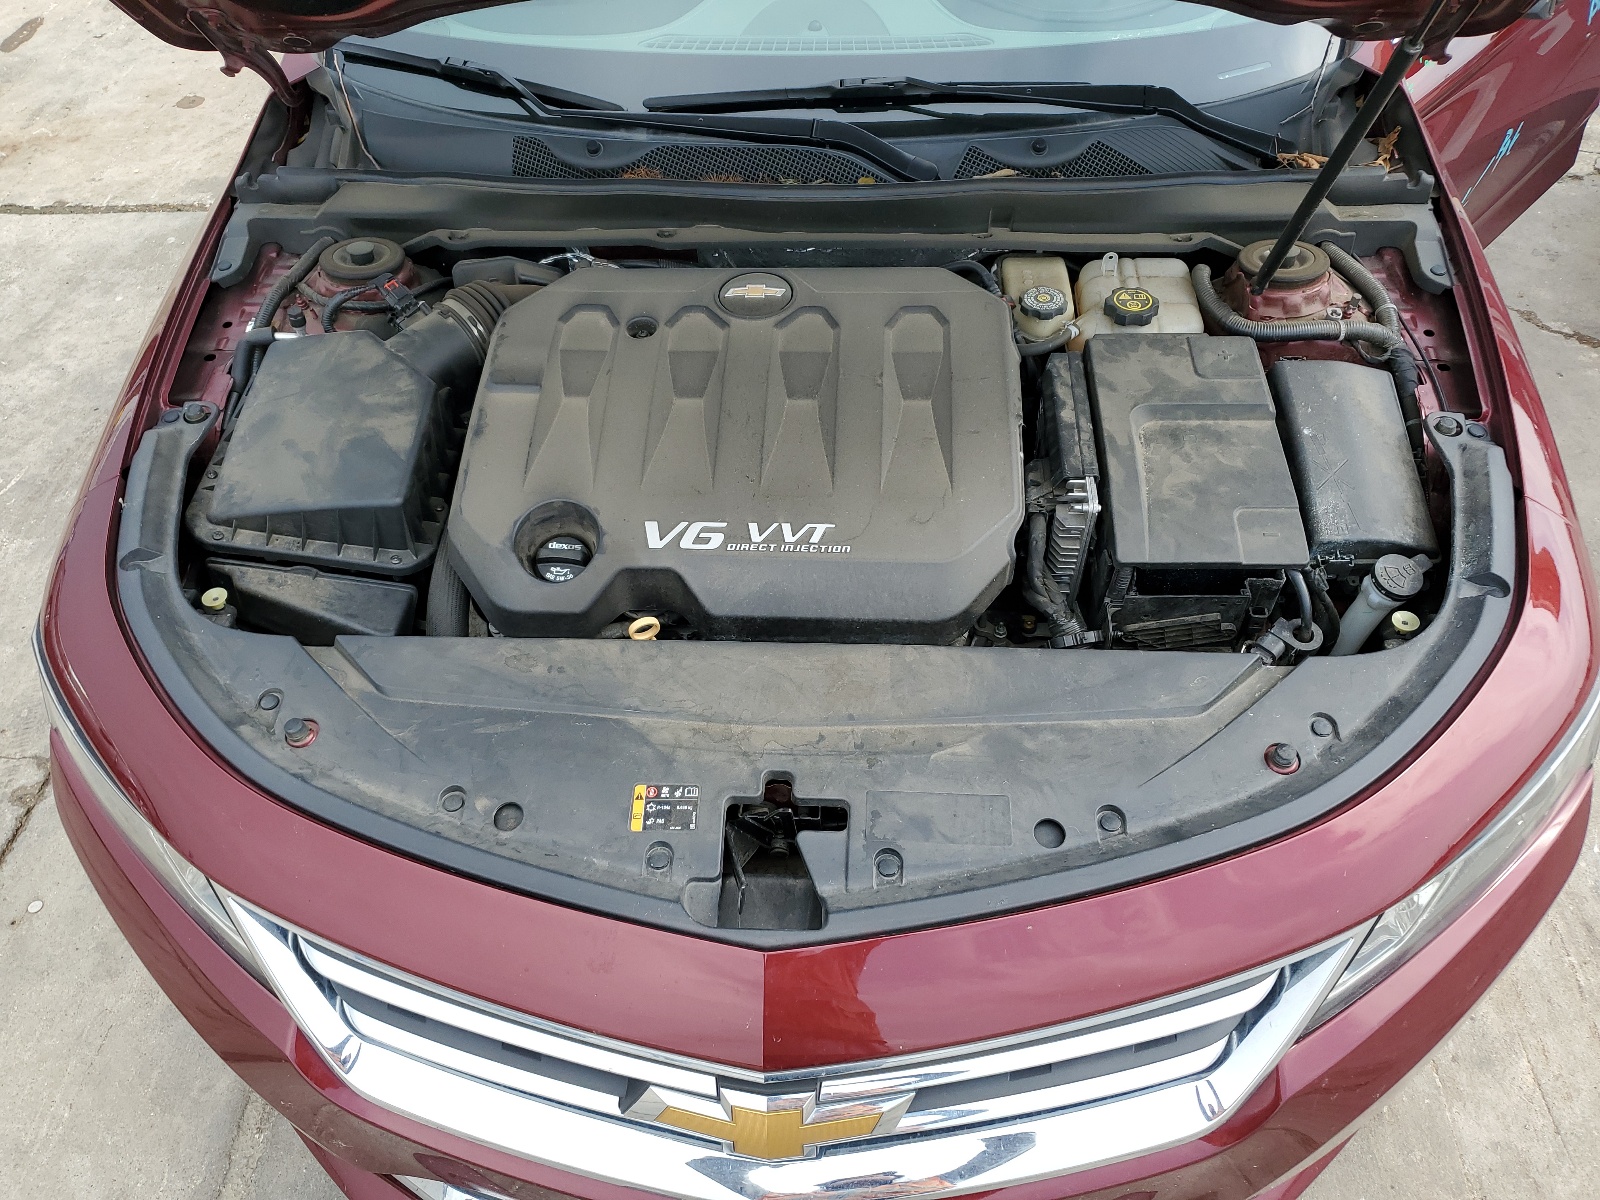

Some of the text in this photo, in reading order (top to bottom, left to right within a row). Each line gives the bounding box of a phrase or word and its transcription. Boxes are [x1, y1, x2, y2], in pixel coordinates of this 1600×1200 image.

[645, 520, 836, 550] V6 VVT
[548, 541, 583, 551] dexos
[726, 543, 851, 553] DIRECT INJECTION
